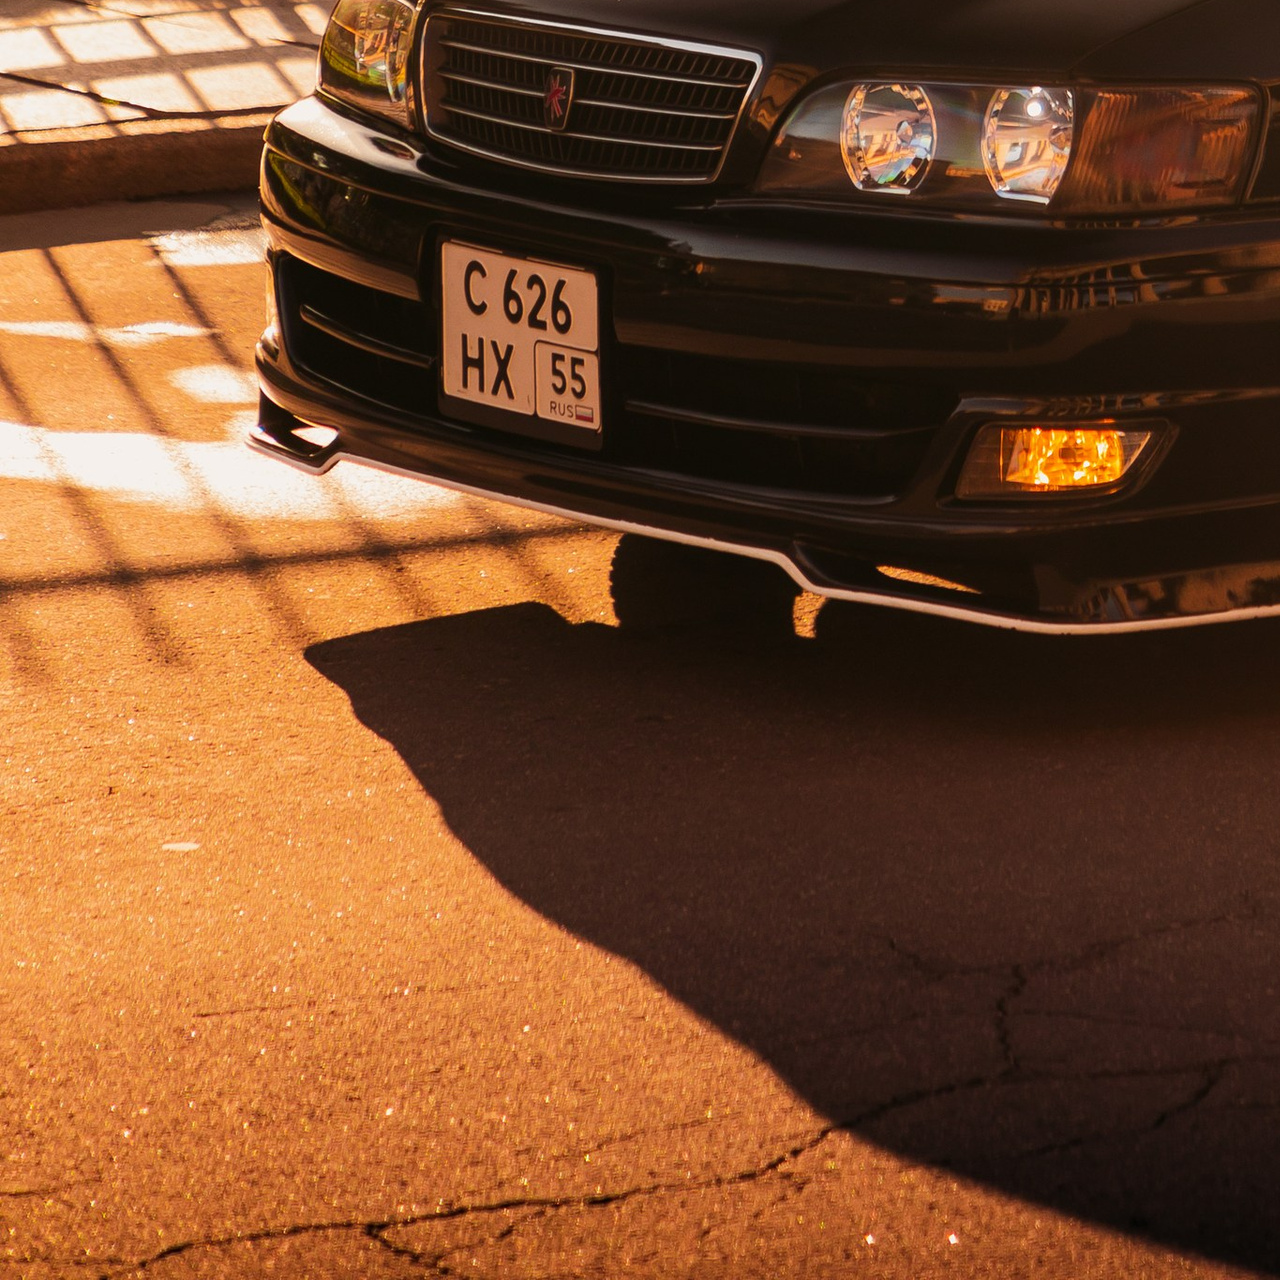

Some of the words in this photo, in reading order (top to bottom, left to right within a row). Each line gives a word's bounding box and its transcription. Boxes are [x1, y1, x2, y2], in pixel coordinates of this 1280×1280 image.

[503, 268, 572, 334] 626
[461, 333, 514, 400] HX
[551, 352, 586, 400] 55
[550, 400, 574, 418] RUS
